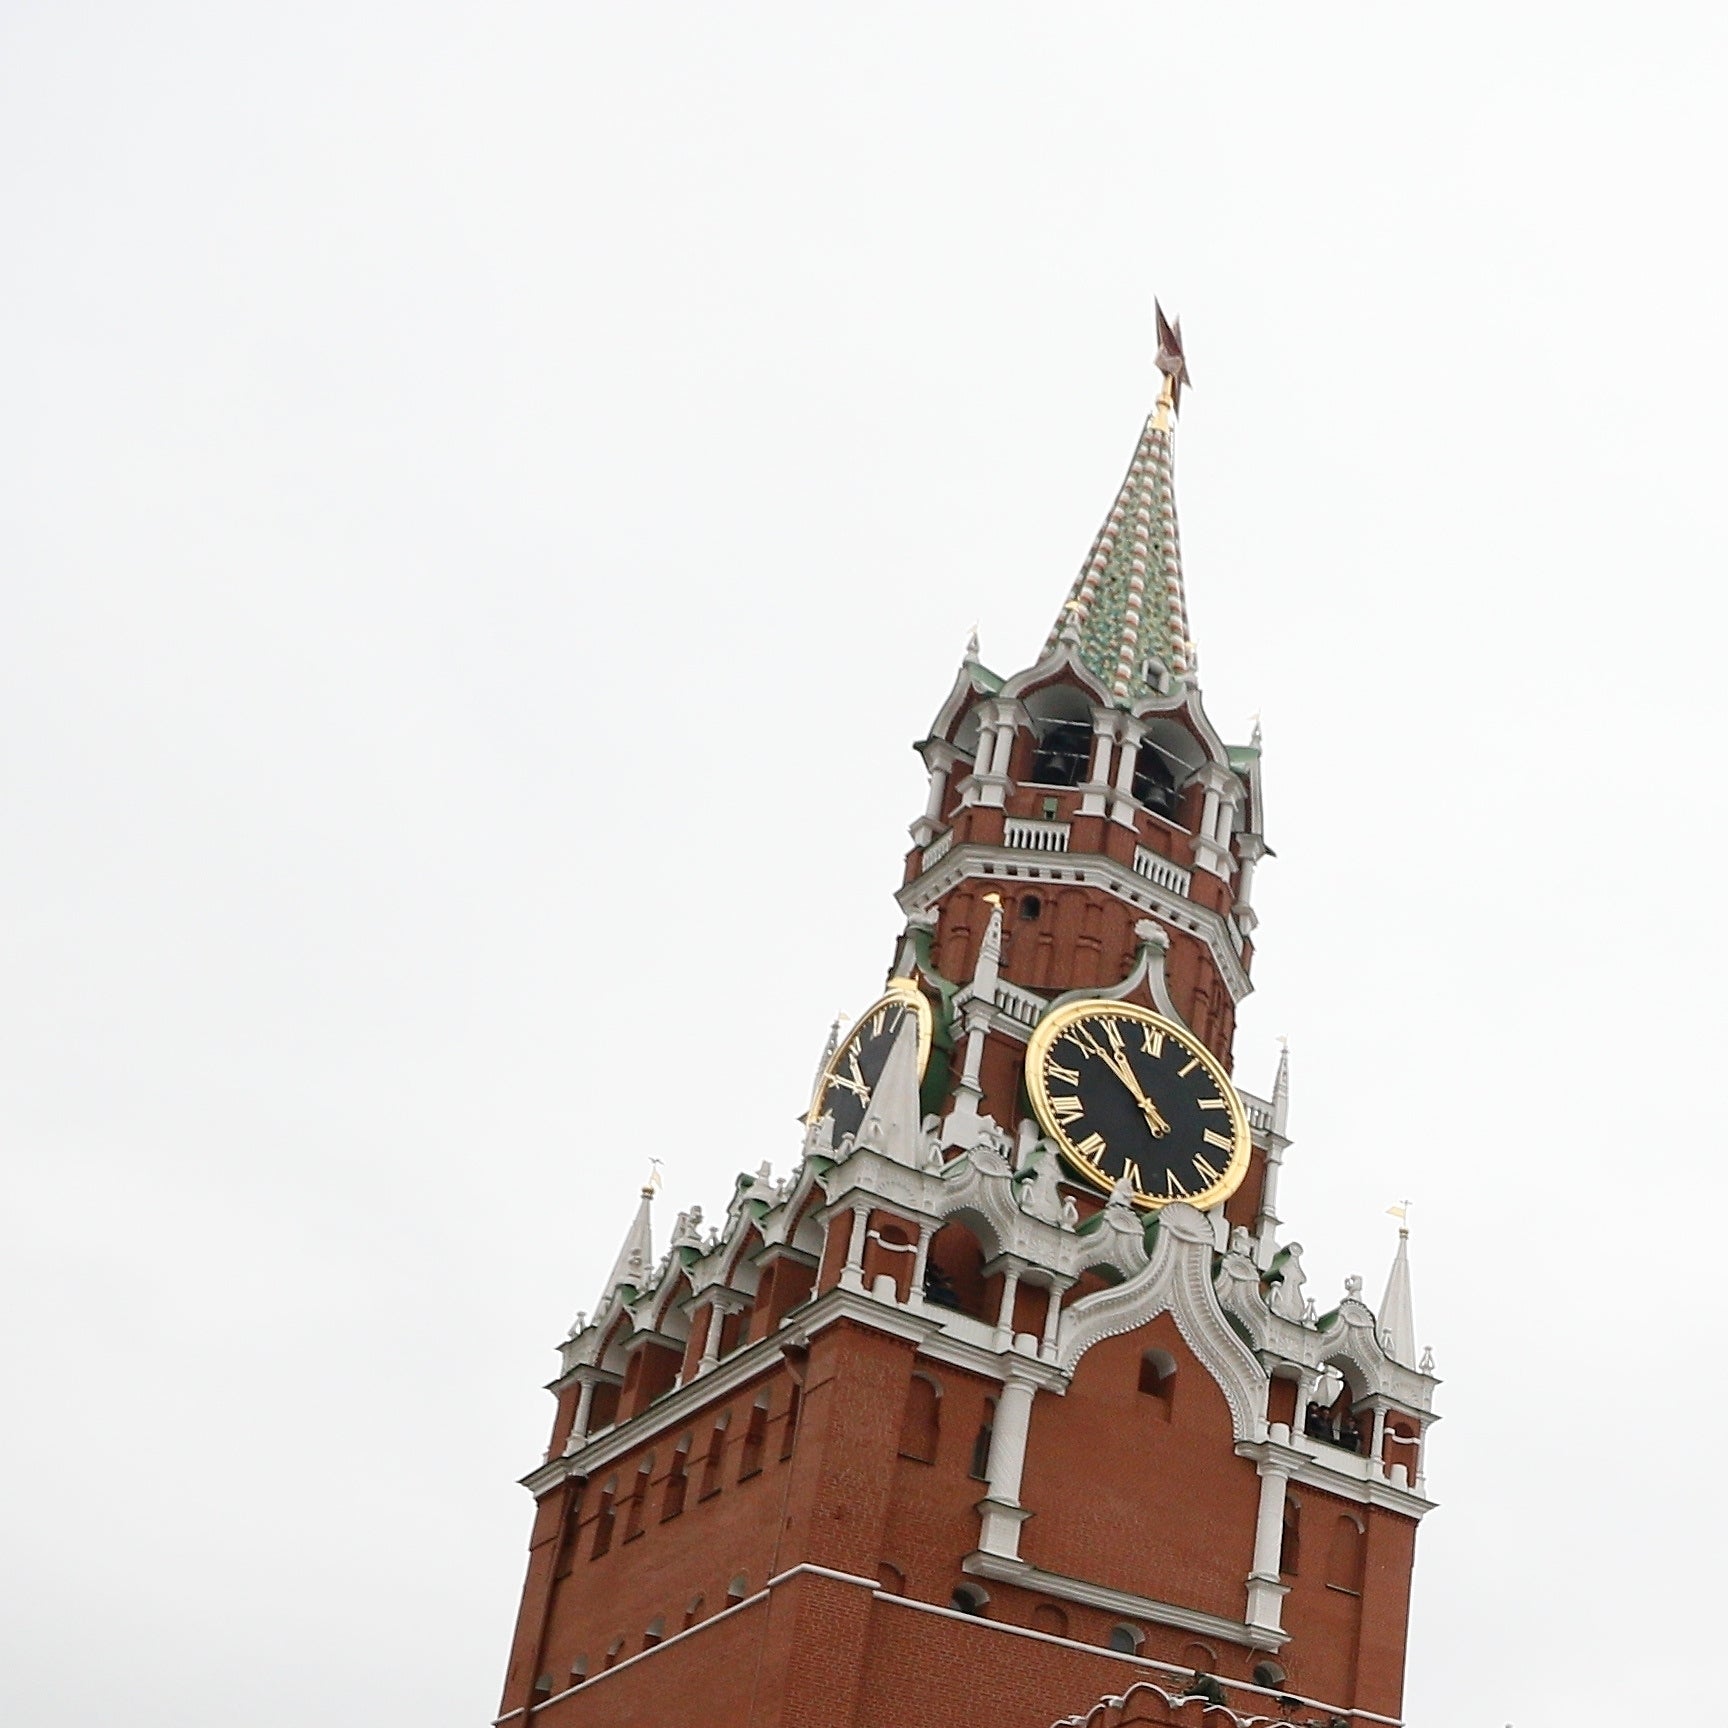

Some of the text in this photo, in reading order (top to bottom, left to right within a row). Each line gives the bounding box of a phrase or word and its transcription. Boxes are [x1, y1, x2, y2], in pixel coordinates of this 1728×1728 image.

[1140, 1023, 1164, 1059] XII
[1048, 1062, 1080, 1087] IX
[1177, 1058, 1199, 1077] I
[1197, 1098, 1226, 1110] II
[1077, 1131, 1106, 1166] VII
[1203, 1128, 1232, 1152] III
[1166, 1167, 1189, 1197] V
